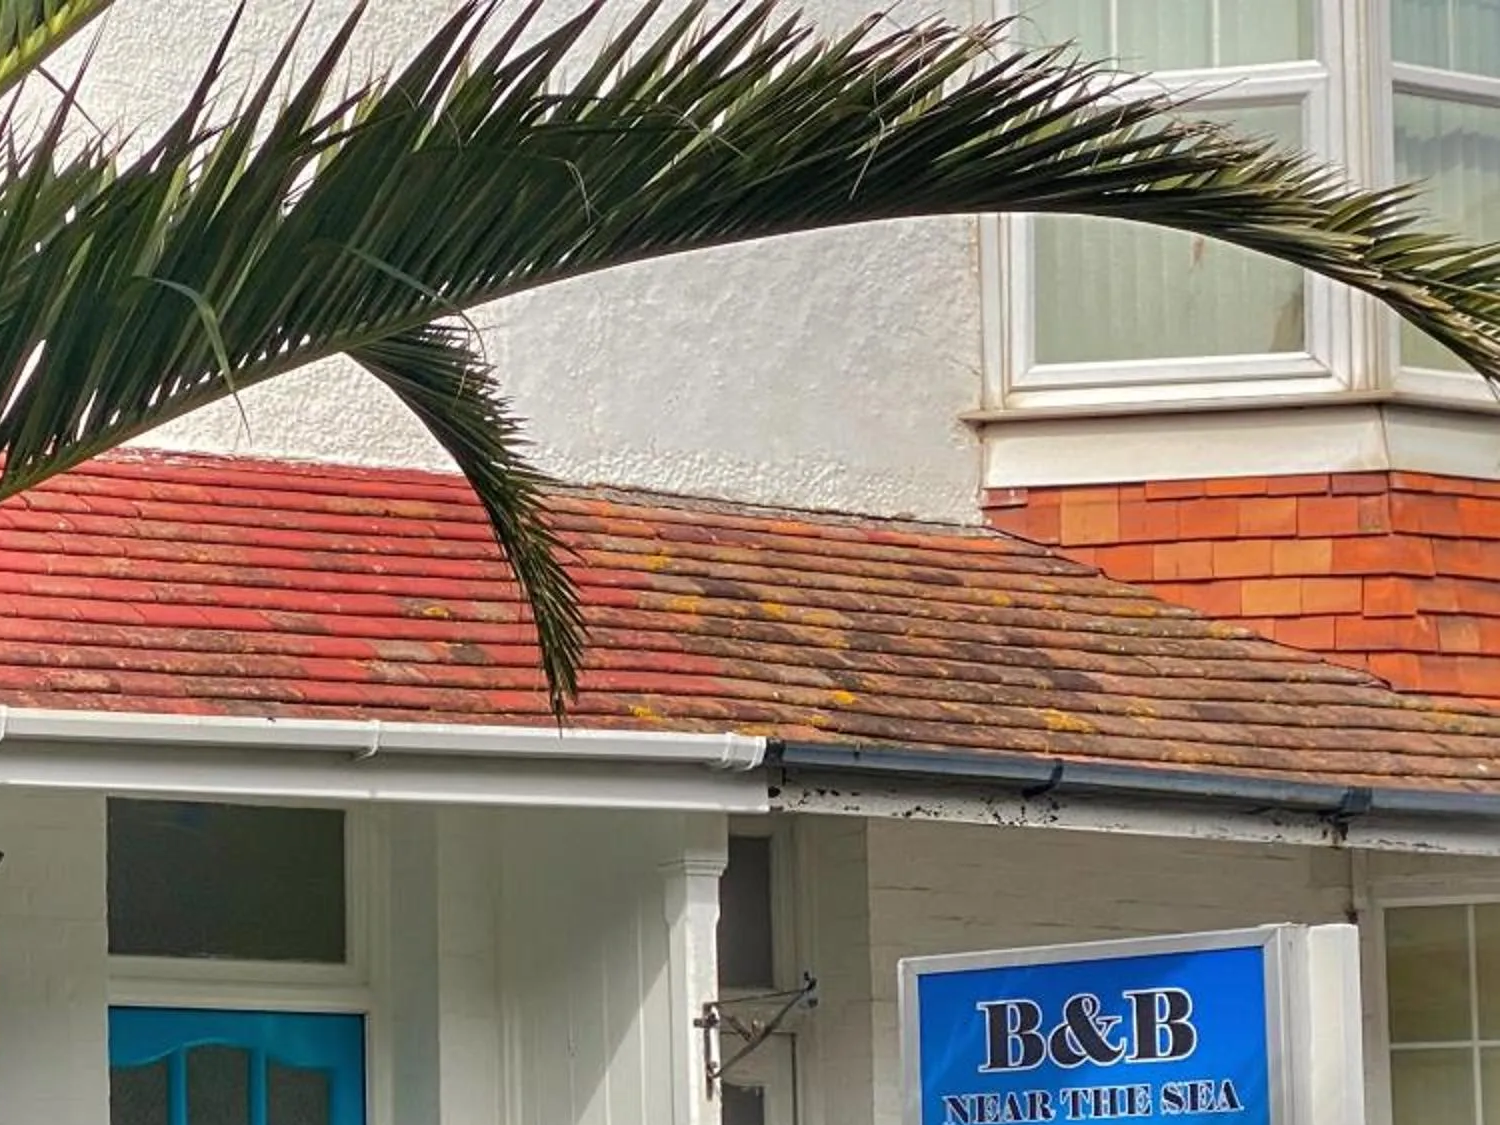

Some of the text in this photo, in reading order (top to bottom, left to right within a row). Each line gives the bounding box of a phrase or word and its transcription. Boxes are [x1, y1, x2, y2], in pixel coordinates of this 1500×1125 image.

[976, 987, 1197, 1072] B&B
[1060, 1084, 1151, 1120] THE
[1161, 1080, 1244, 1116] SEA
